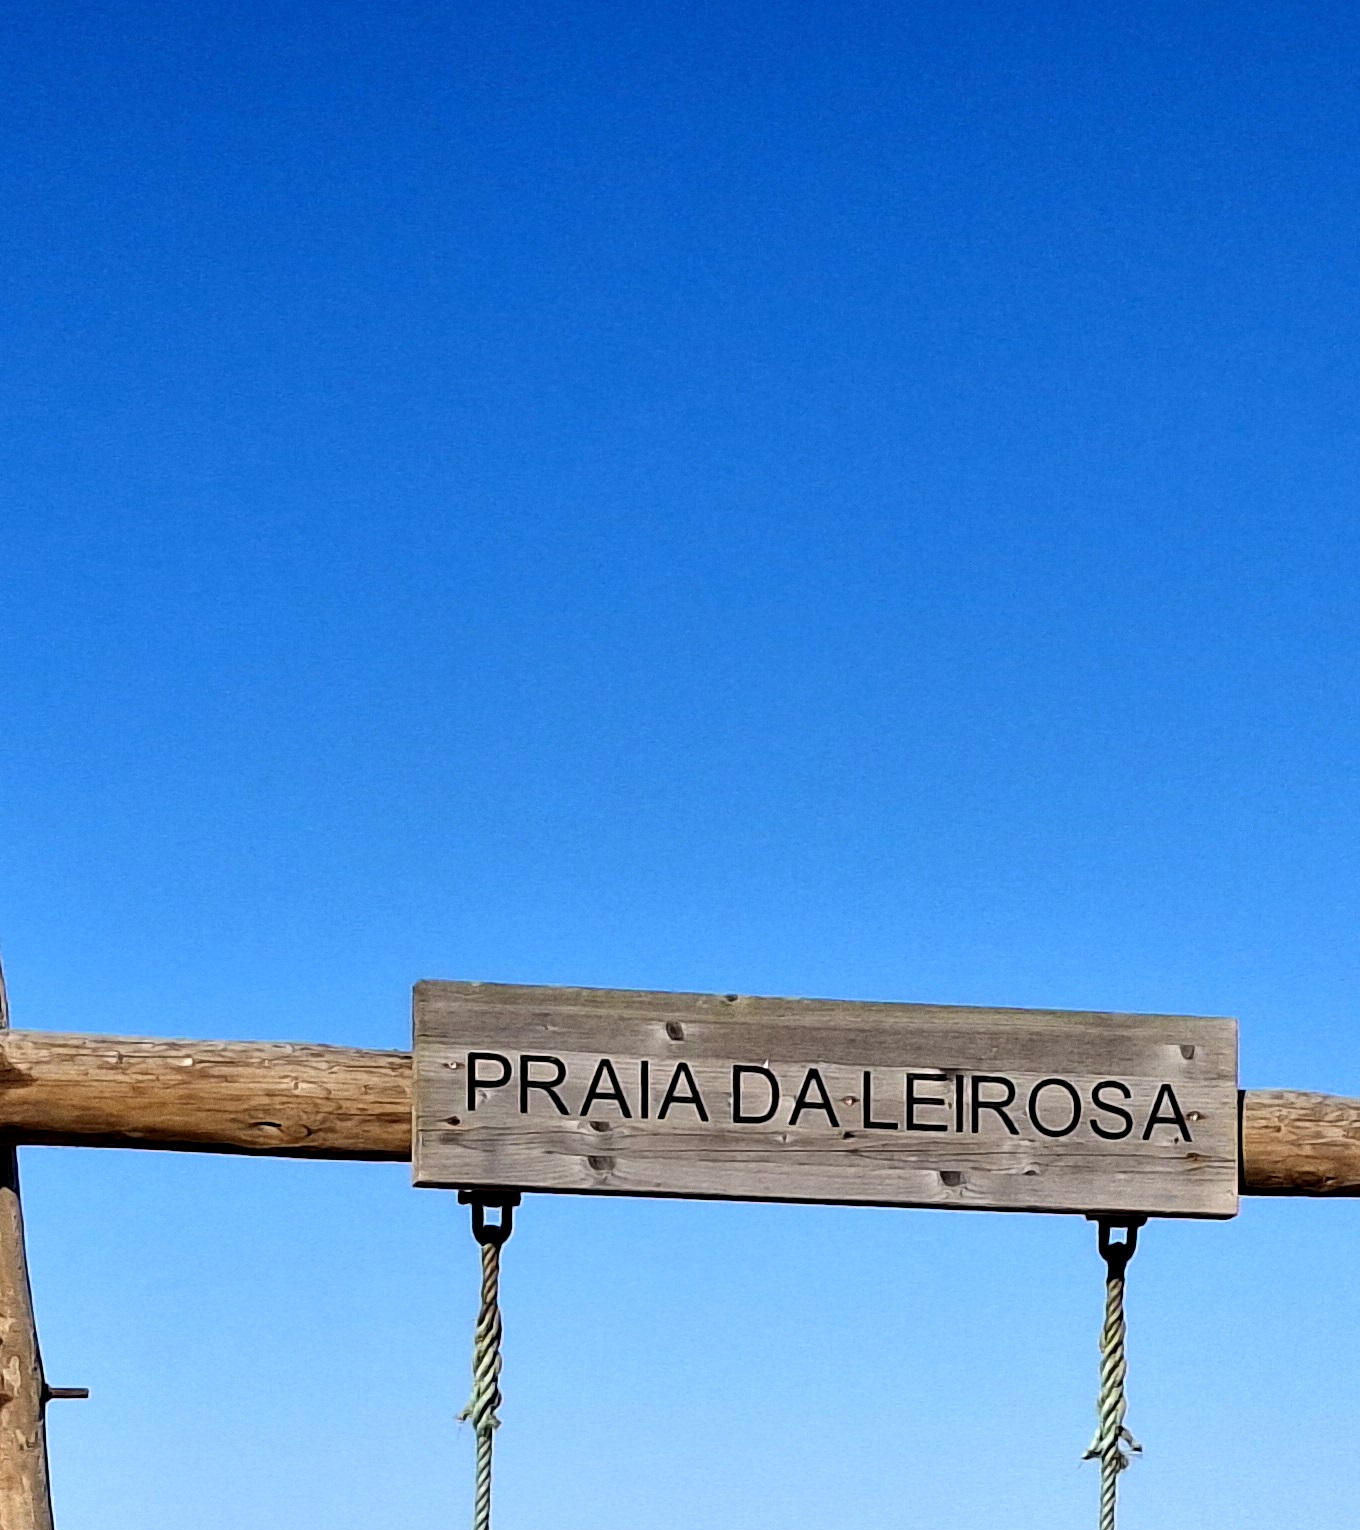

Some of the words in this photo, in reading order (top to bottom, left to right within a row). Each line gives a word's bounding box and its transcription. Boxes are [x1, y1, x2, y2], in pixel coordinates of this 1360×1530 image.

[466, 1052, 709, 1123] PRAIA
[733, 1065, 840, 1128] DA
[863, 1071, 1192, 1142] LEIROSA
